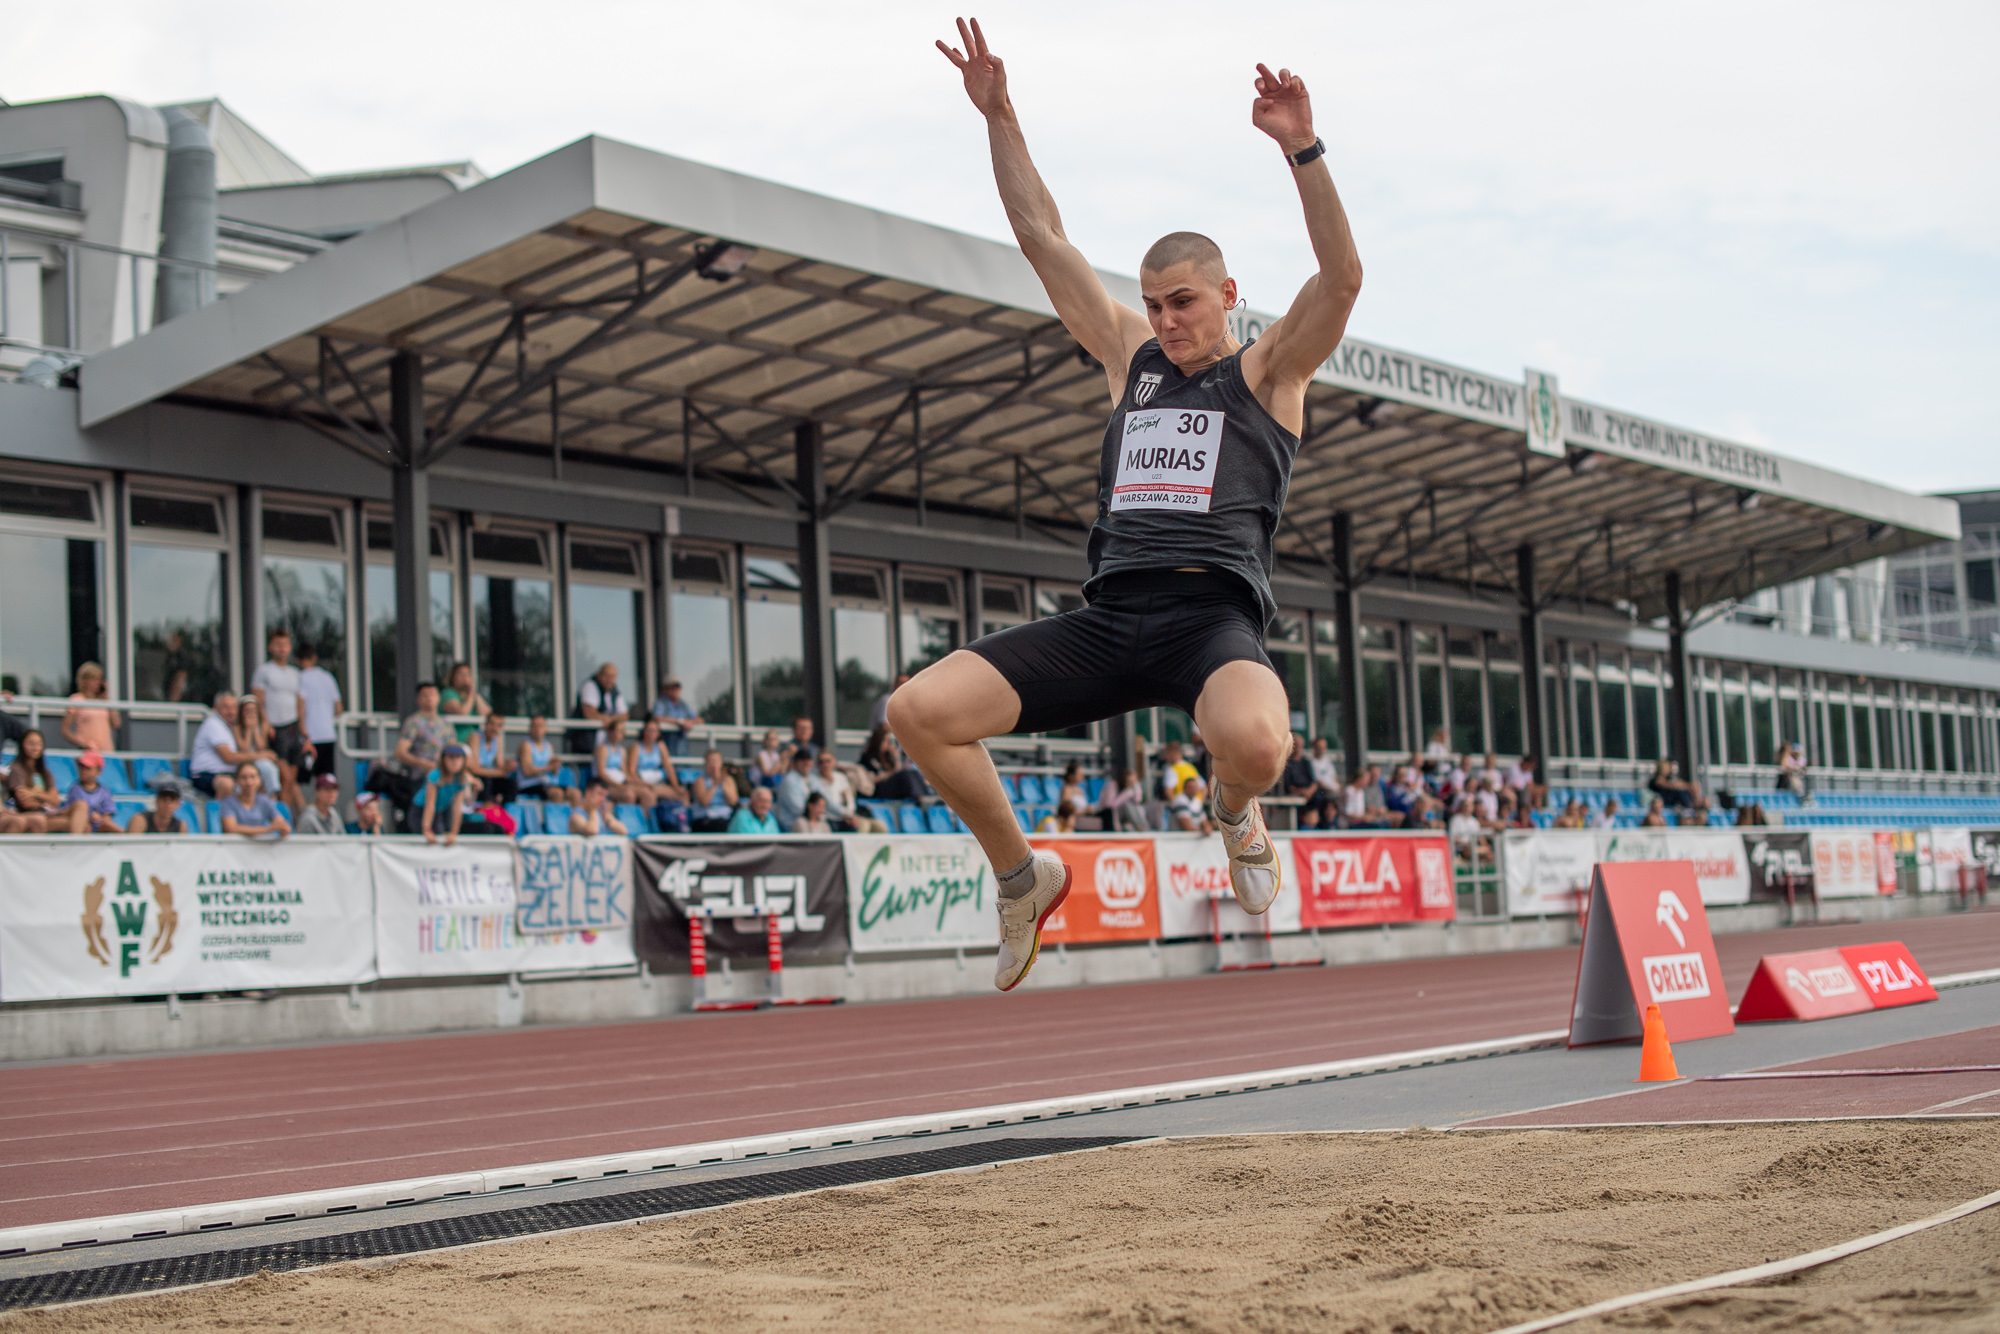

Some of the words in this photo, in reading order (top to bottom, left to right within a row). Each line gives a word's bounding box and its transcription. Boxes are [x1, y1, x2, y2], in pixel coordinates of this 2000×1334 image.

[1318, 343, 1517, 418] KKOATLETYCZNY
[1177, 412, 1209, 435] 30
[1125, 447, 1207, 472] MURIAS
[1605, 414, 1703, 466] ZYGMUNTA
[1706, 442, 1782, 484] SZELESTA
[1119, 493, 1170, 504] WARSZAWA
[1172, 494, 1199, 504] 2023
[1241, 822, 1257, 851] NIKE
[901, 855, 967, 873] INTER
[1311, 848, 1402, 896] PZLA
[197, 871, 276, 886] AKADEMIA
[658, 858, 708, 899] 4F
[197, 890, 304, 906] WYCHOWANIA
[201, 909, 291, 926] FIZYCZNEGO
[1651, 959, 1704, 994] ORLEN
[1816, 968, 1852, 992] ORLEN
[1857, 957, 1924, 993] PZLA
